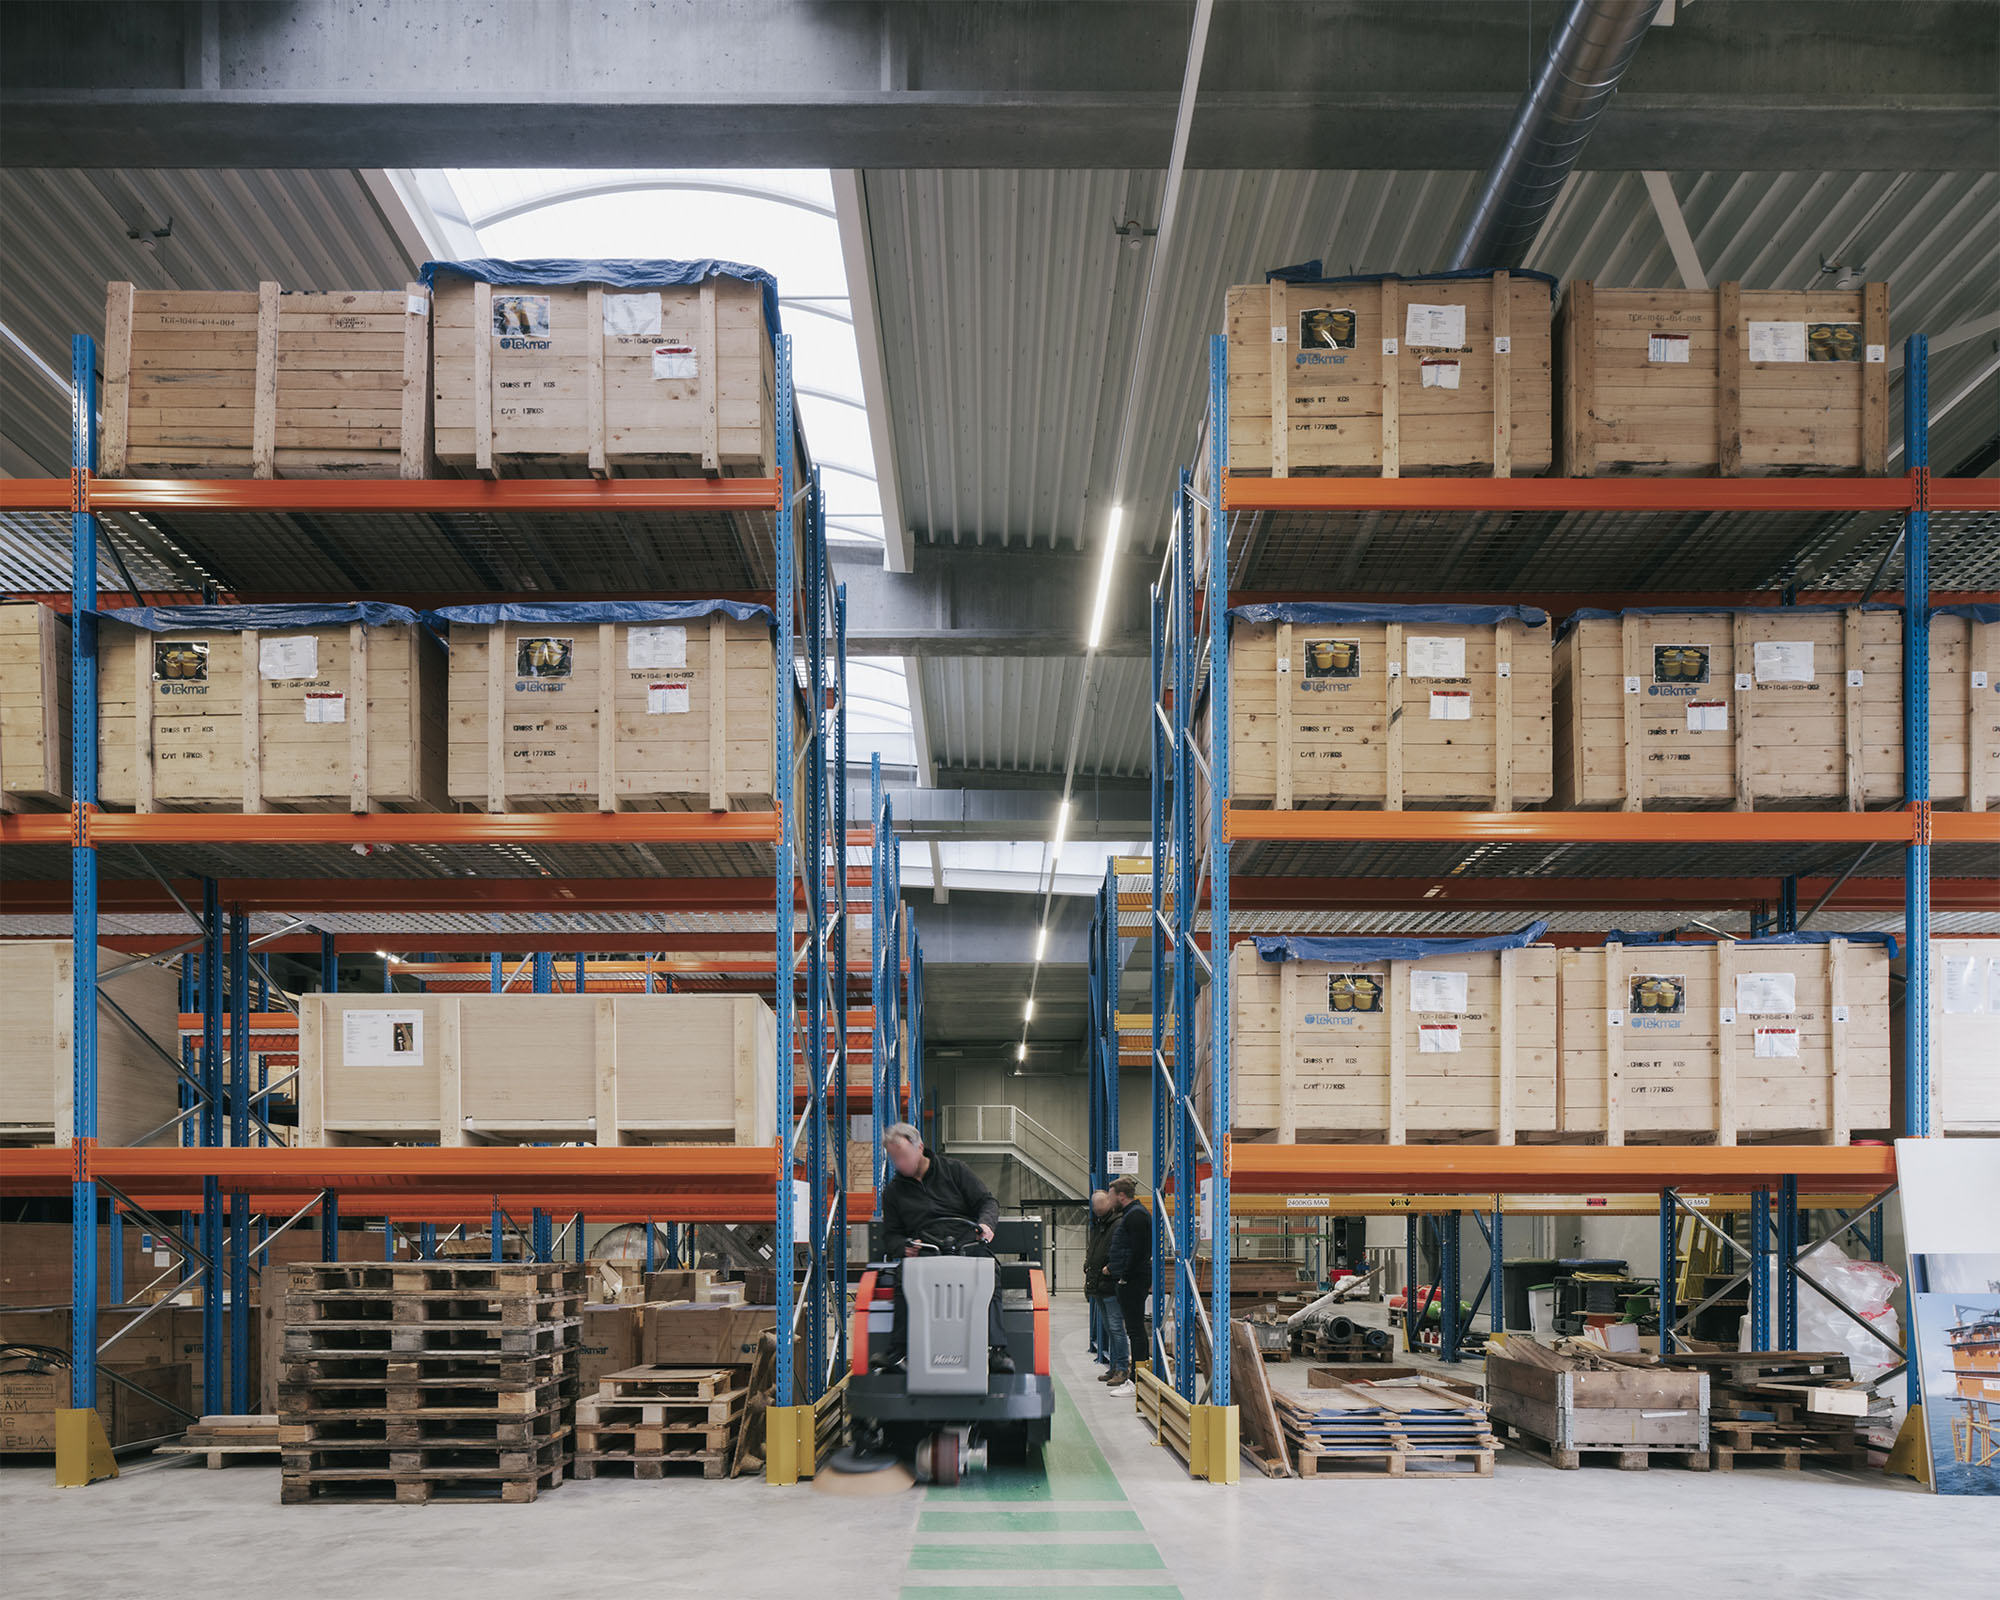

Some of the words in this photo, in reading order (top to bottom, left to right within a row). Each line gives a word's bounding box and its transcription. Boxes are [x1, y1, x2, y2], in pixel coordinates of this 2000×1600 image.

[510, 337, 552, 350] Tekmar
[1306, 353, 1349, 365] Tekmar
[170, 683, 210, 695] Tekmar
[525, 680, 567, 692] Tekmar
[1311, 680, 1352, 692] Tekmar
[1657, 685, 1700, 696] Tekmar
[1313, 1013, 1356, 1025] Tekmar
[1640, 1017, 1683, 1029] Tekmar
